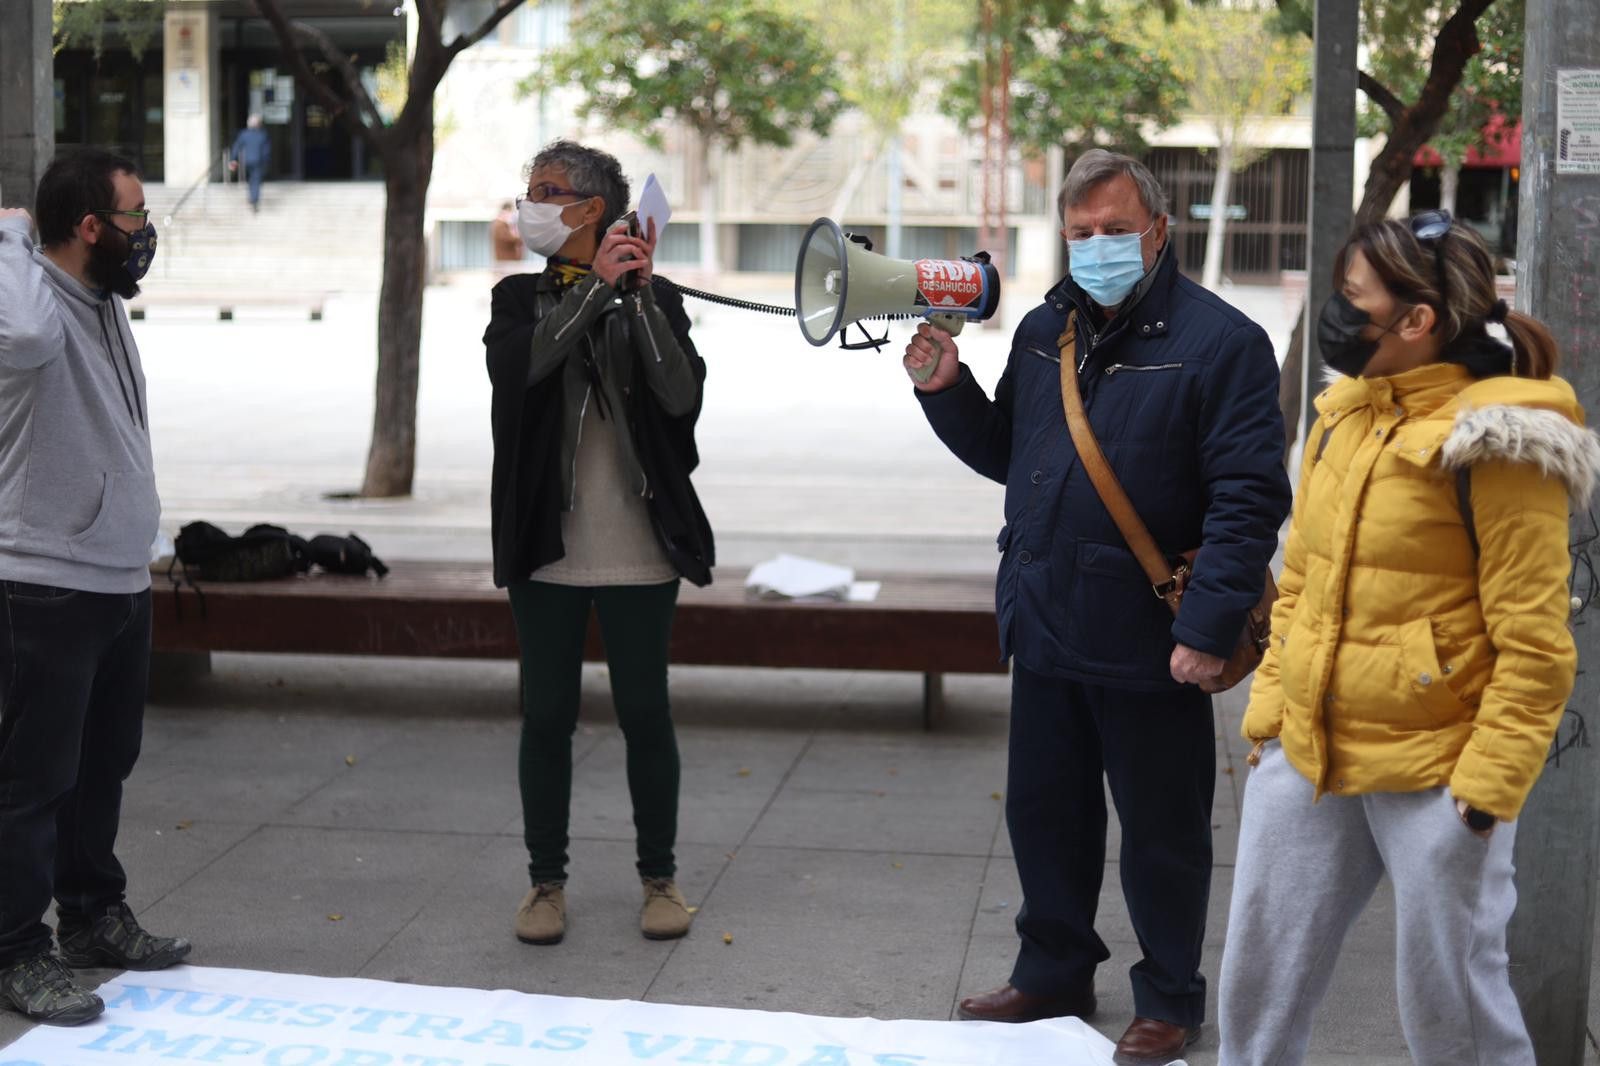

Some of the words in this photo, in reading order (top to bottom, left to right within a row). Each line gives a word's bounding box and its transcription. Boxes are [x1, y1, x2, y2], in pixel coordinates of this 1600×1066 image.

[922, 280, 978, 294] DESAHUCIOS
[106, 984, 594, 1051] NUESTRAS
[78, 1024, 512, 1066] IMPOR
